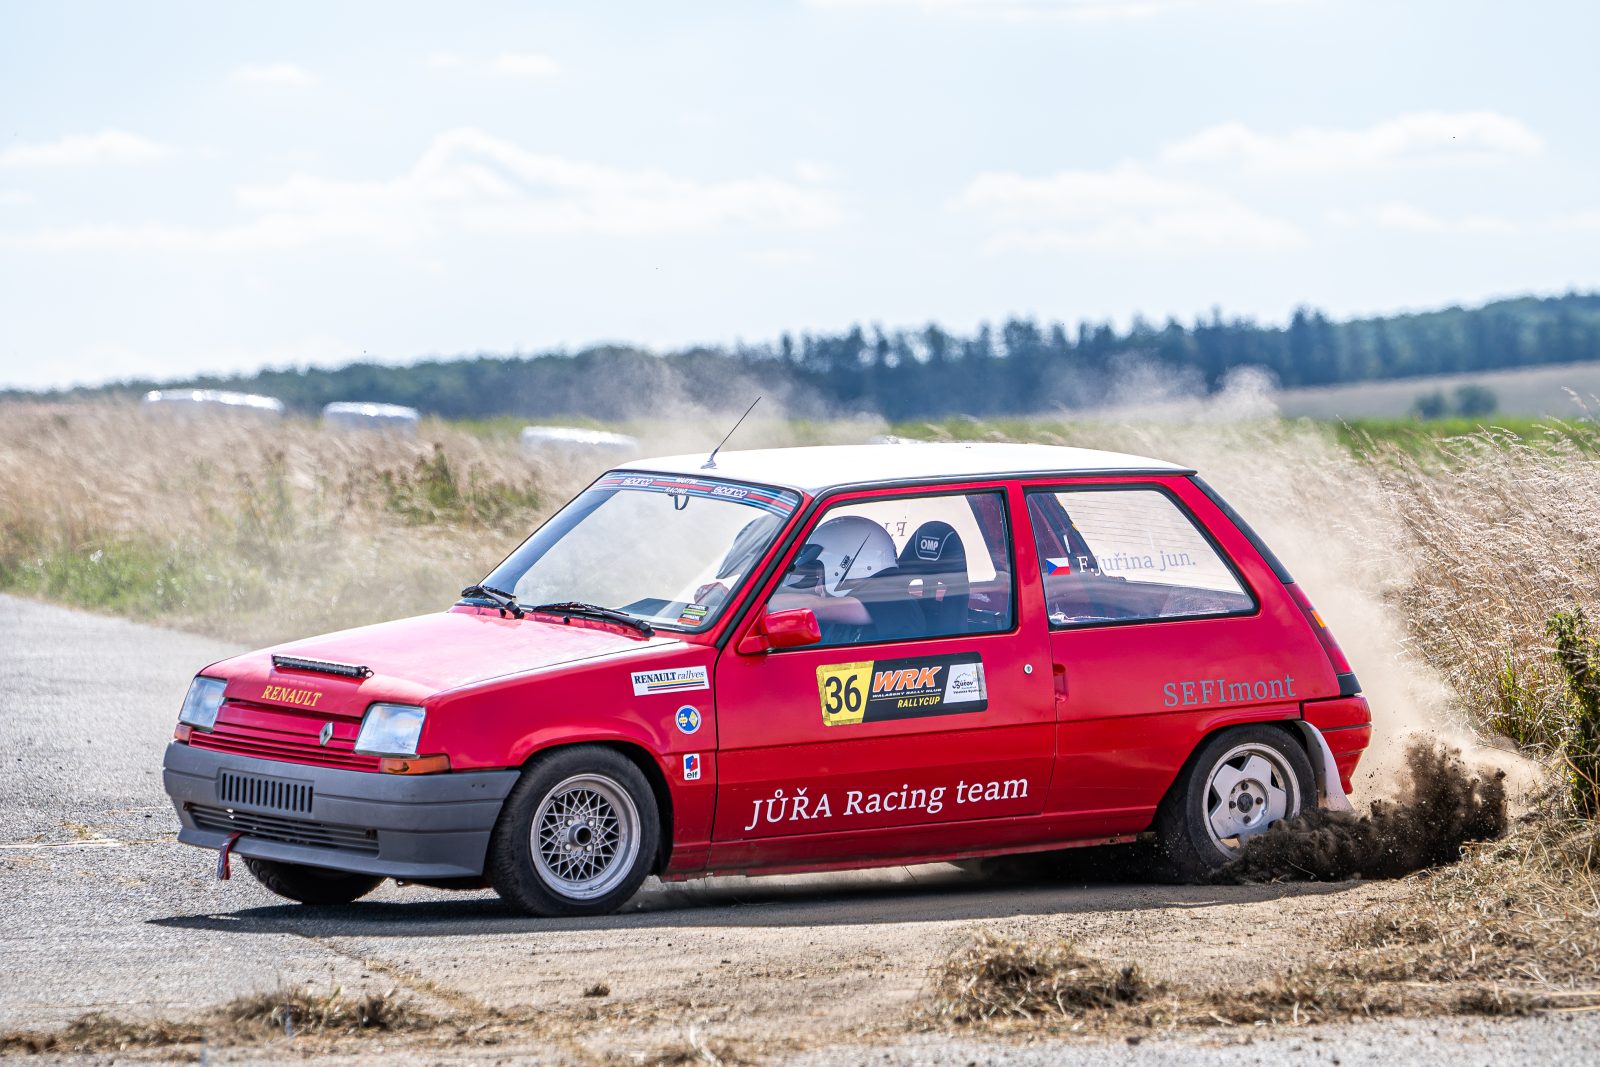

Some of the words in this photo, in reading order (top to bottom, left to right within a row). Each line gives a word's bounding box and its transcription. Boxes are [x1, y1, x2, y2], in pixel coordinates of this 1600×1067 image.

[920, 538, 939, 551] OMP
[1159, 550, 1196, 572] jun.
[634, 671, 677, 685] RENAULT
[677, 669, 705, 682] rallyes
[872, 666, 942, 693] WRK
[261, 685, 323, 707] RENAULT
[825, 674, 862, 715] 36
[1163, 674, 1297, 707] SEFImont
[897, 695, 941, 709] RALLYCUP
[686, 771, 698, 779] elf
[744, 786, 832, 831] JŮŘA
[843, 783, 946, 814] Racing
[956, 778, 1028, 804] team
